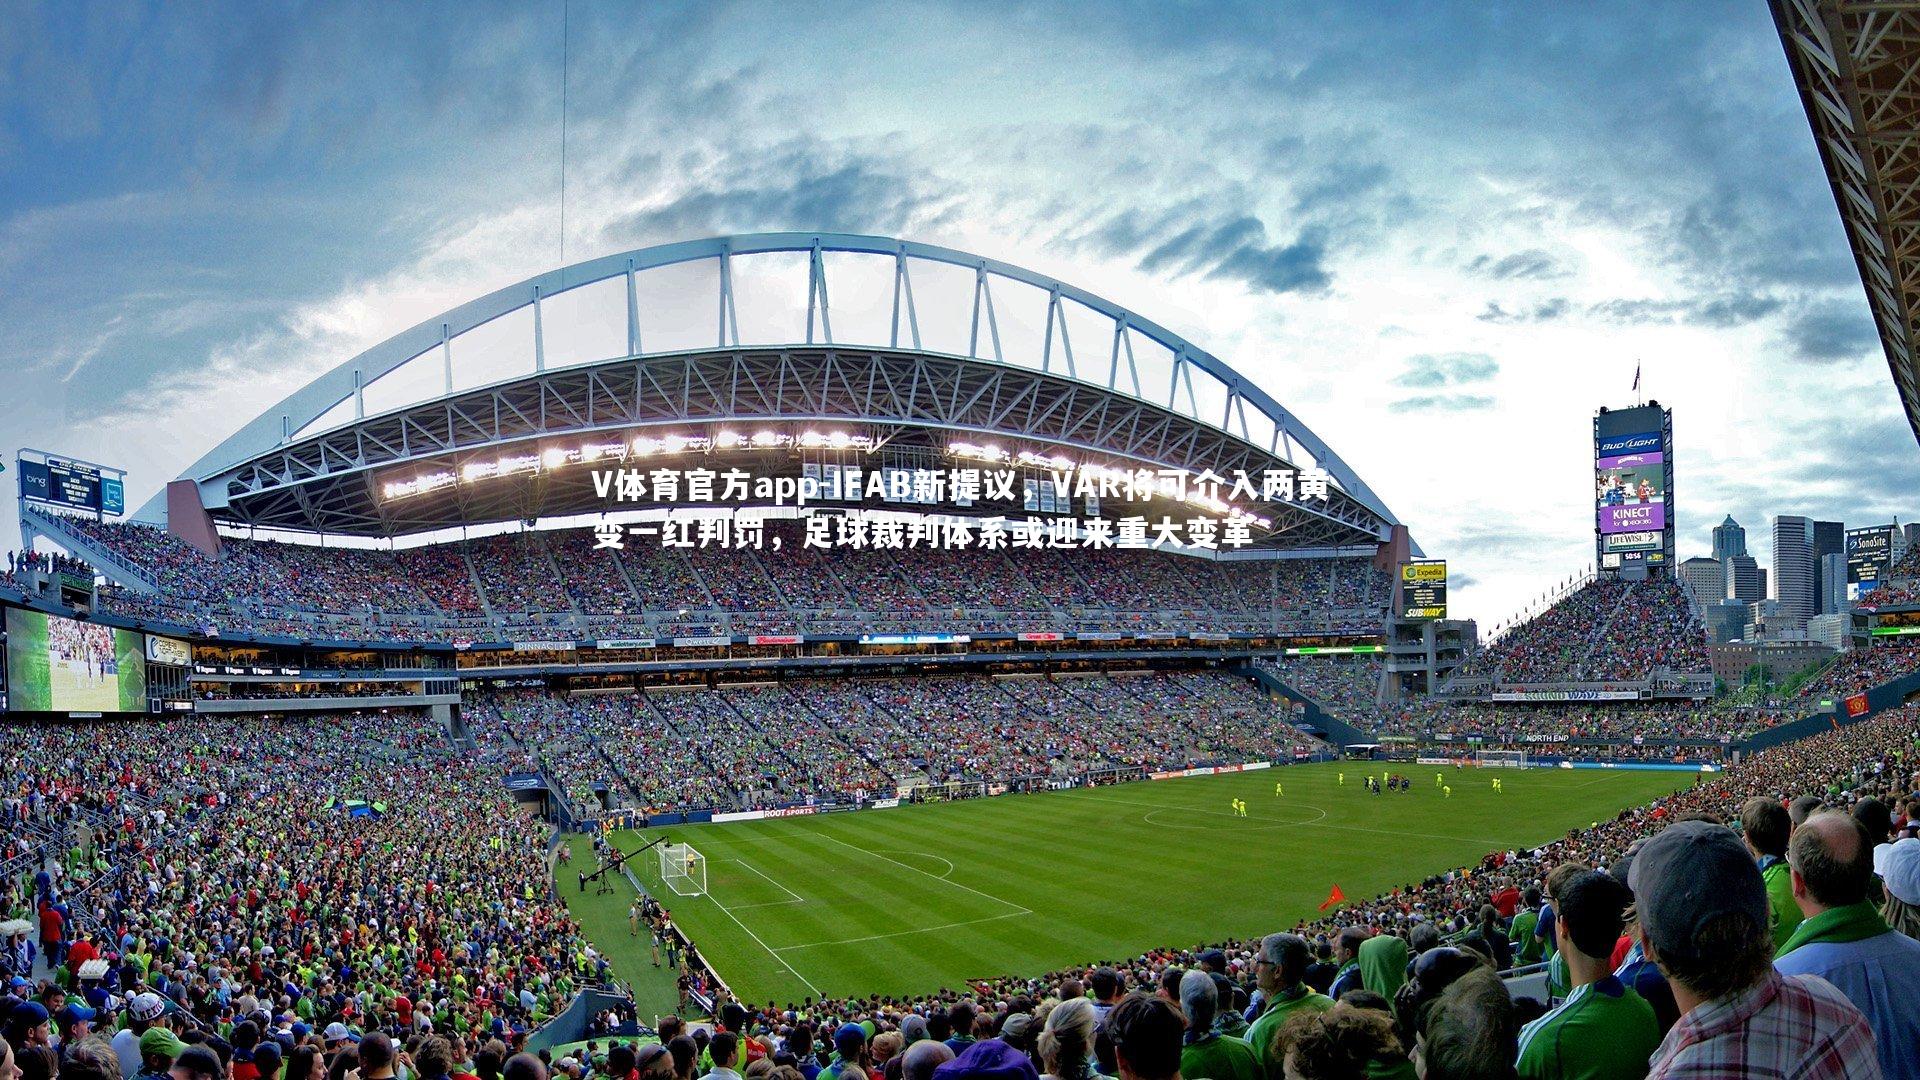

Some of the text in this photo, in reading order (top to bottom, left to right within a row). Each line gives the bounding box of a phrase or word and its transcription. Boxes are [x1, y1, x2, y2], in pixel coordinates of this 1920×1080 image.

[1601, 438, 1659, 451] BUD LIGHT
[26, 474, 46, 488] bing
[1613, 507, 1653, 519] KINECT
[1858, 535, 1886, 549] SonoSite
[1416, 568, 1442, 577] Expedia
[1405, 608, 1445, 618] SUBWAY
[765, 808, 786, 818] ROOT
